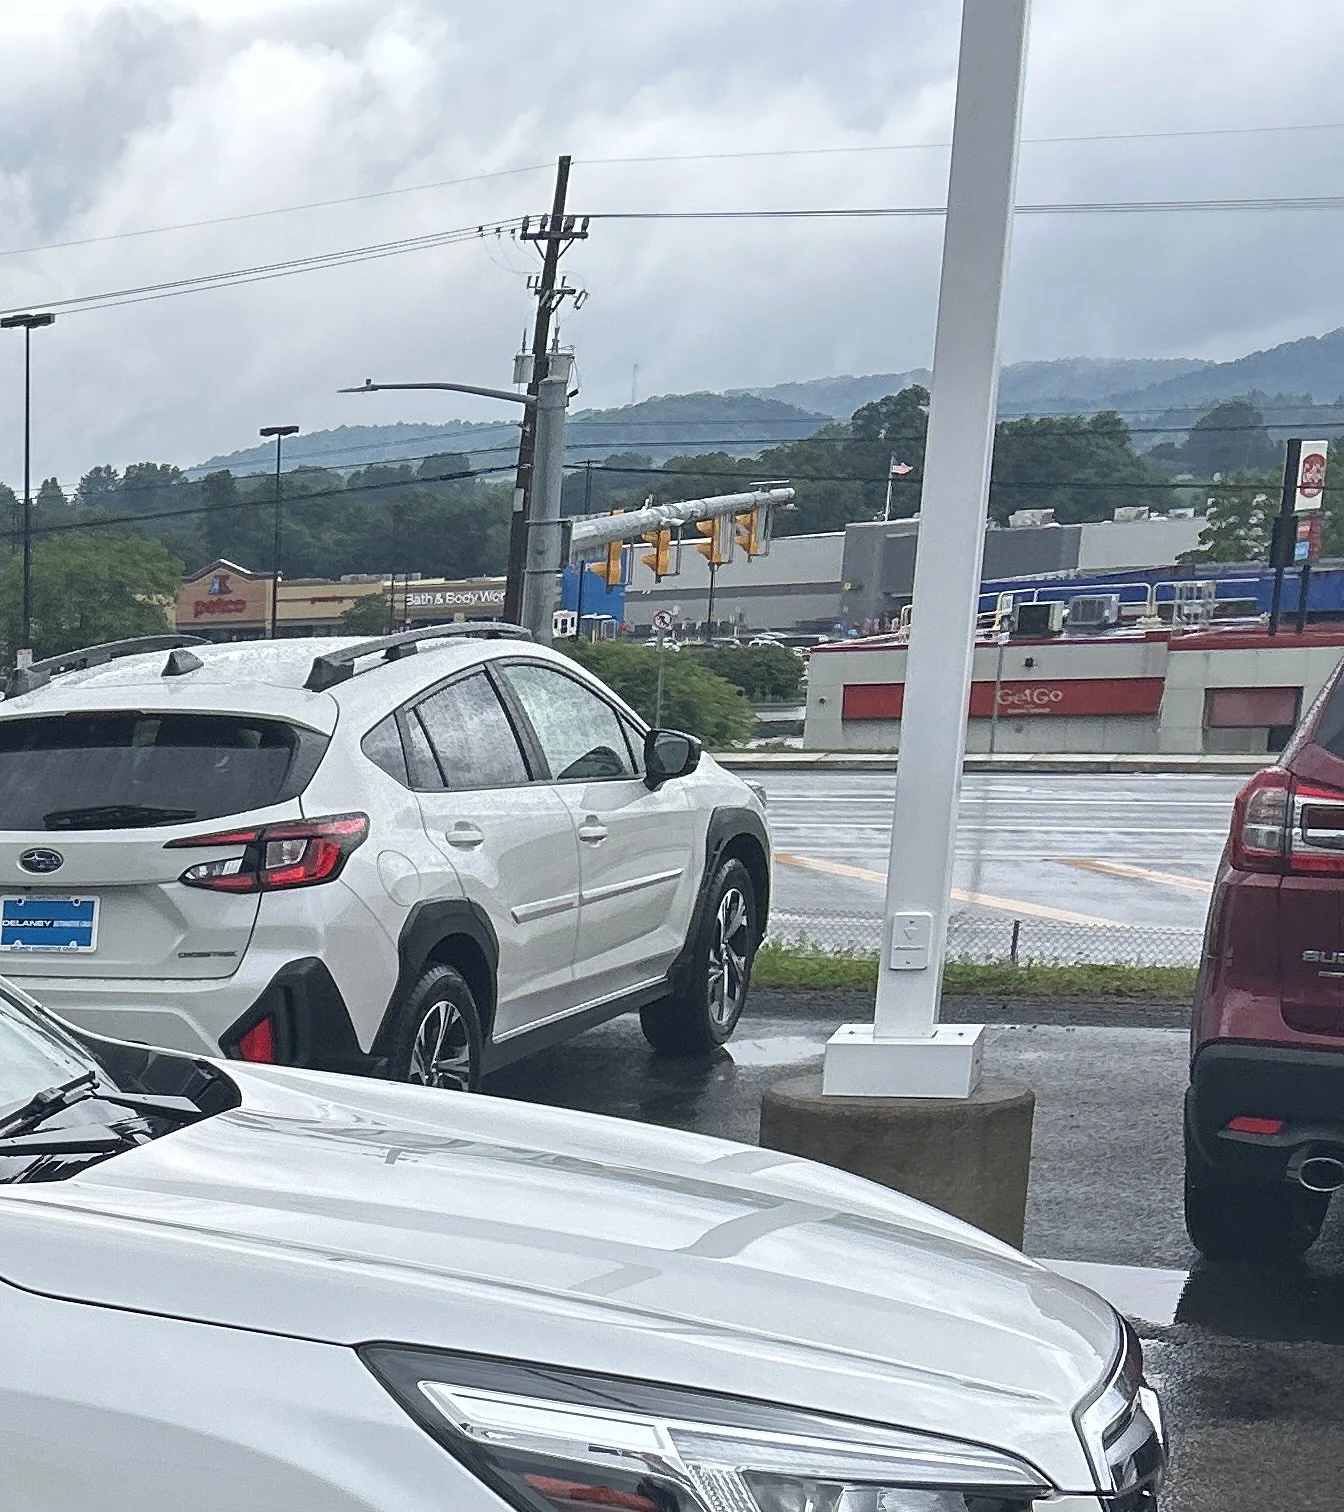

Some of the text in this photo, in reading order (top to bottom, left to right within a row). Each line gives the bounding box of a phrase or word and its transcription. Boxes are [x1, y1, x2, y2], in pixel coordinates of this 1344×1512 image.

[406, 592, 434, 606] Bath
[434, 592, 444, 606] &
[445, 591, 478, 607] Body
[998, 687, 1064, 705] GetGo
[2, 919, 52, 927] DELANEY
